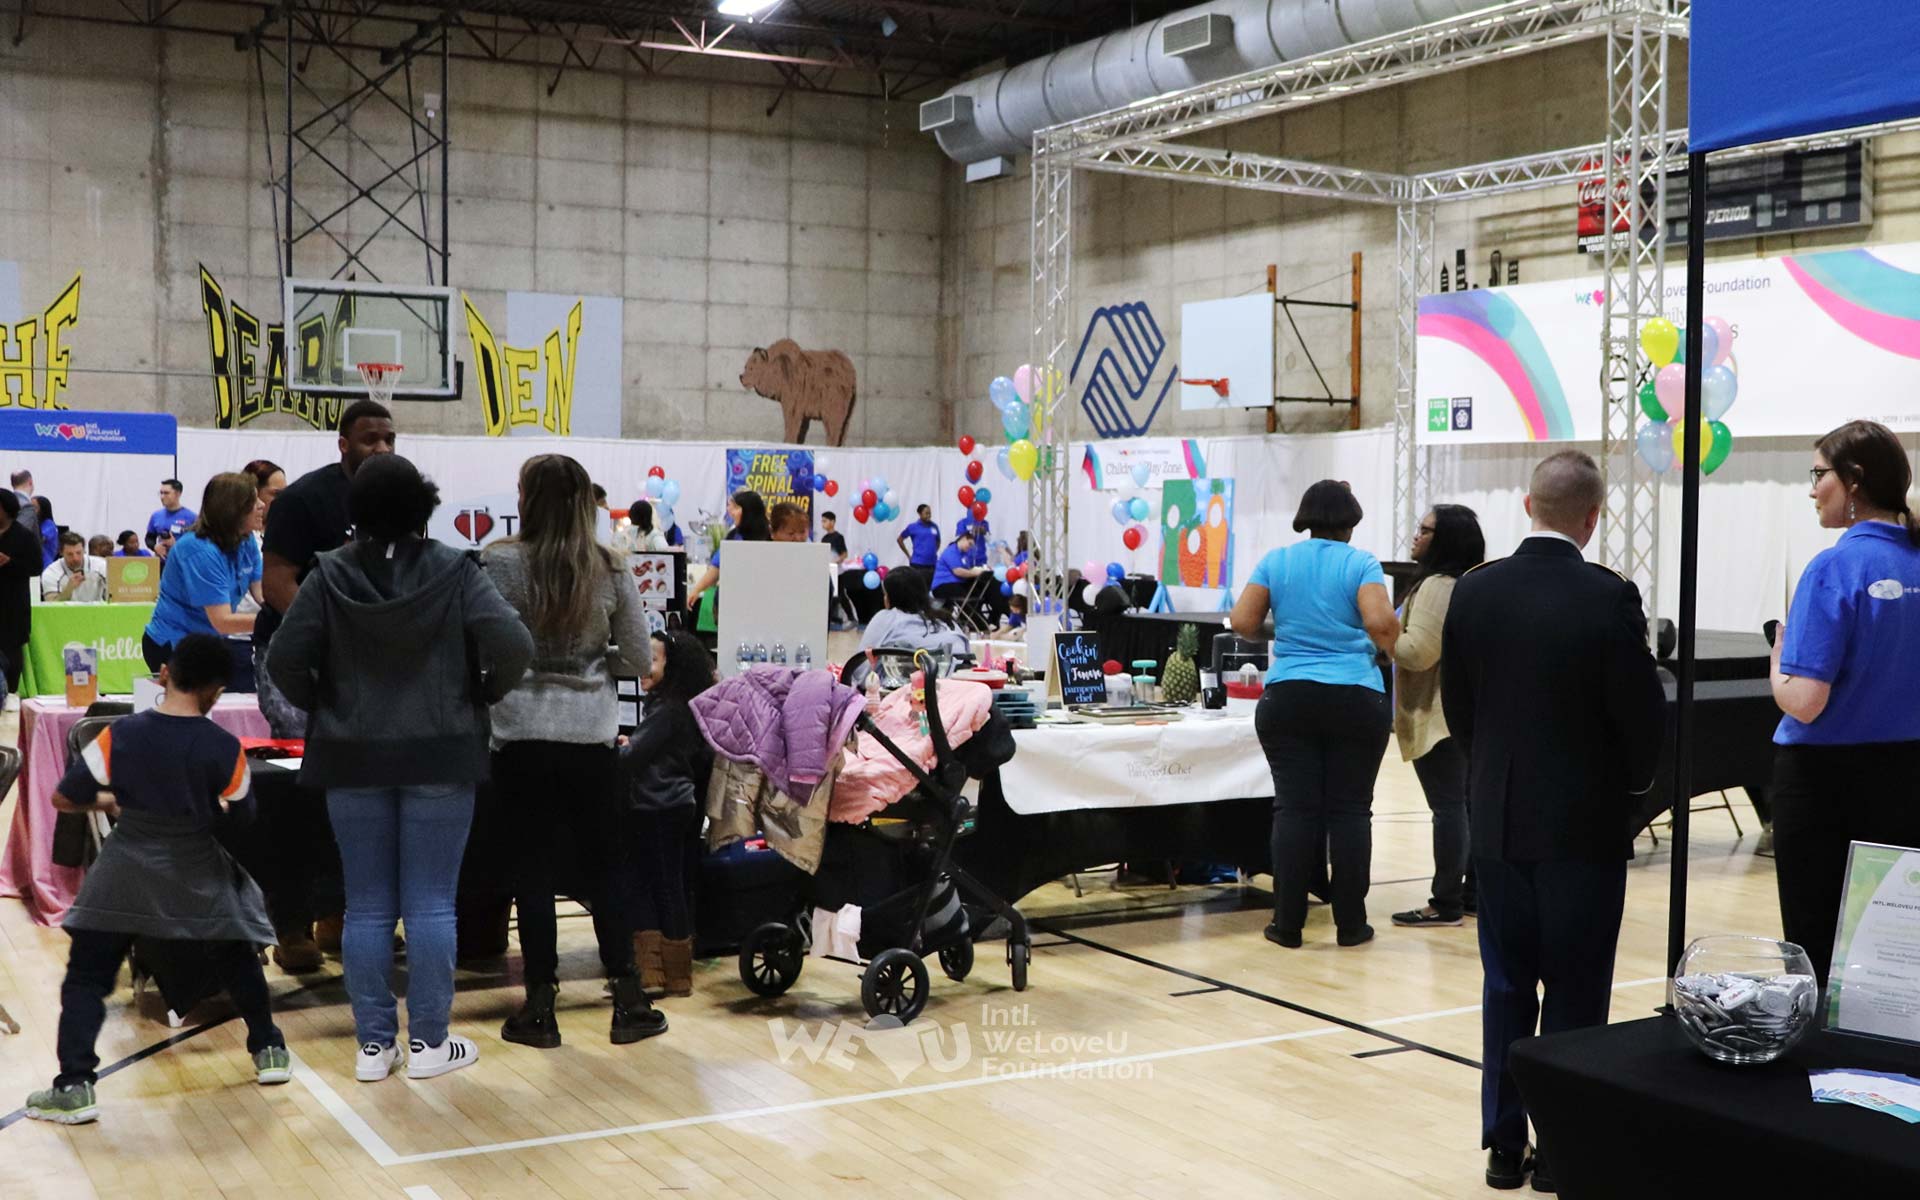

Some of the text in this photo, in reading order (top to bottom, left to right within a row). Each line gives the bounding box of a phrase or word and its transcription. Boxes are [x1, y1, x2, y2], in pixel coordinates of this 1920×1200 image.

[1706, 205, 1751, 225] PERIOD
[461, 289, 583, 436] DEN
[751, 454, 789, 473] FREE
[745, 474, 794, 494] SPINAL
[1070, 655, 1088, 665] with
[1064, 682, 1105, 697] pampered
[1075, 693, 1094, 704] chef
[1168, 761, 1192, 776] Chef
